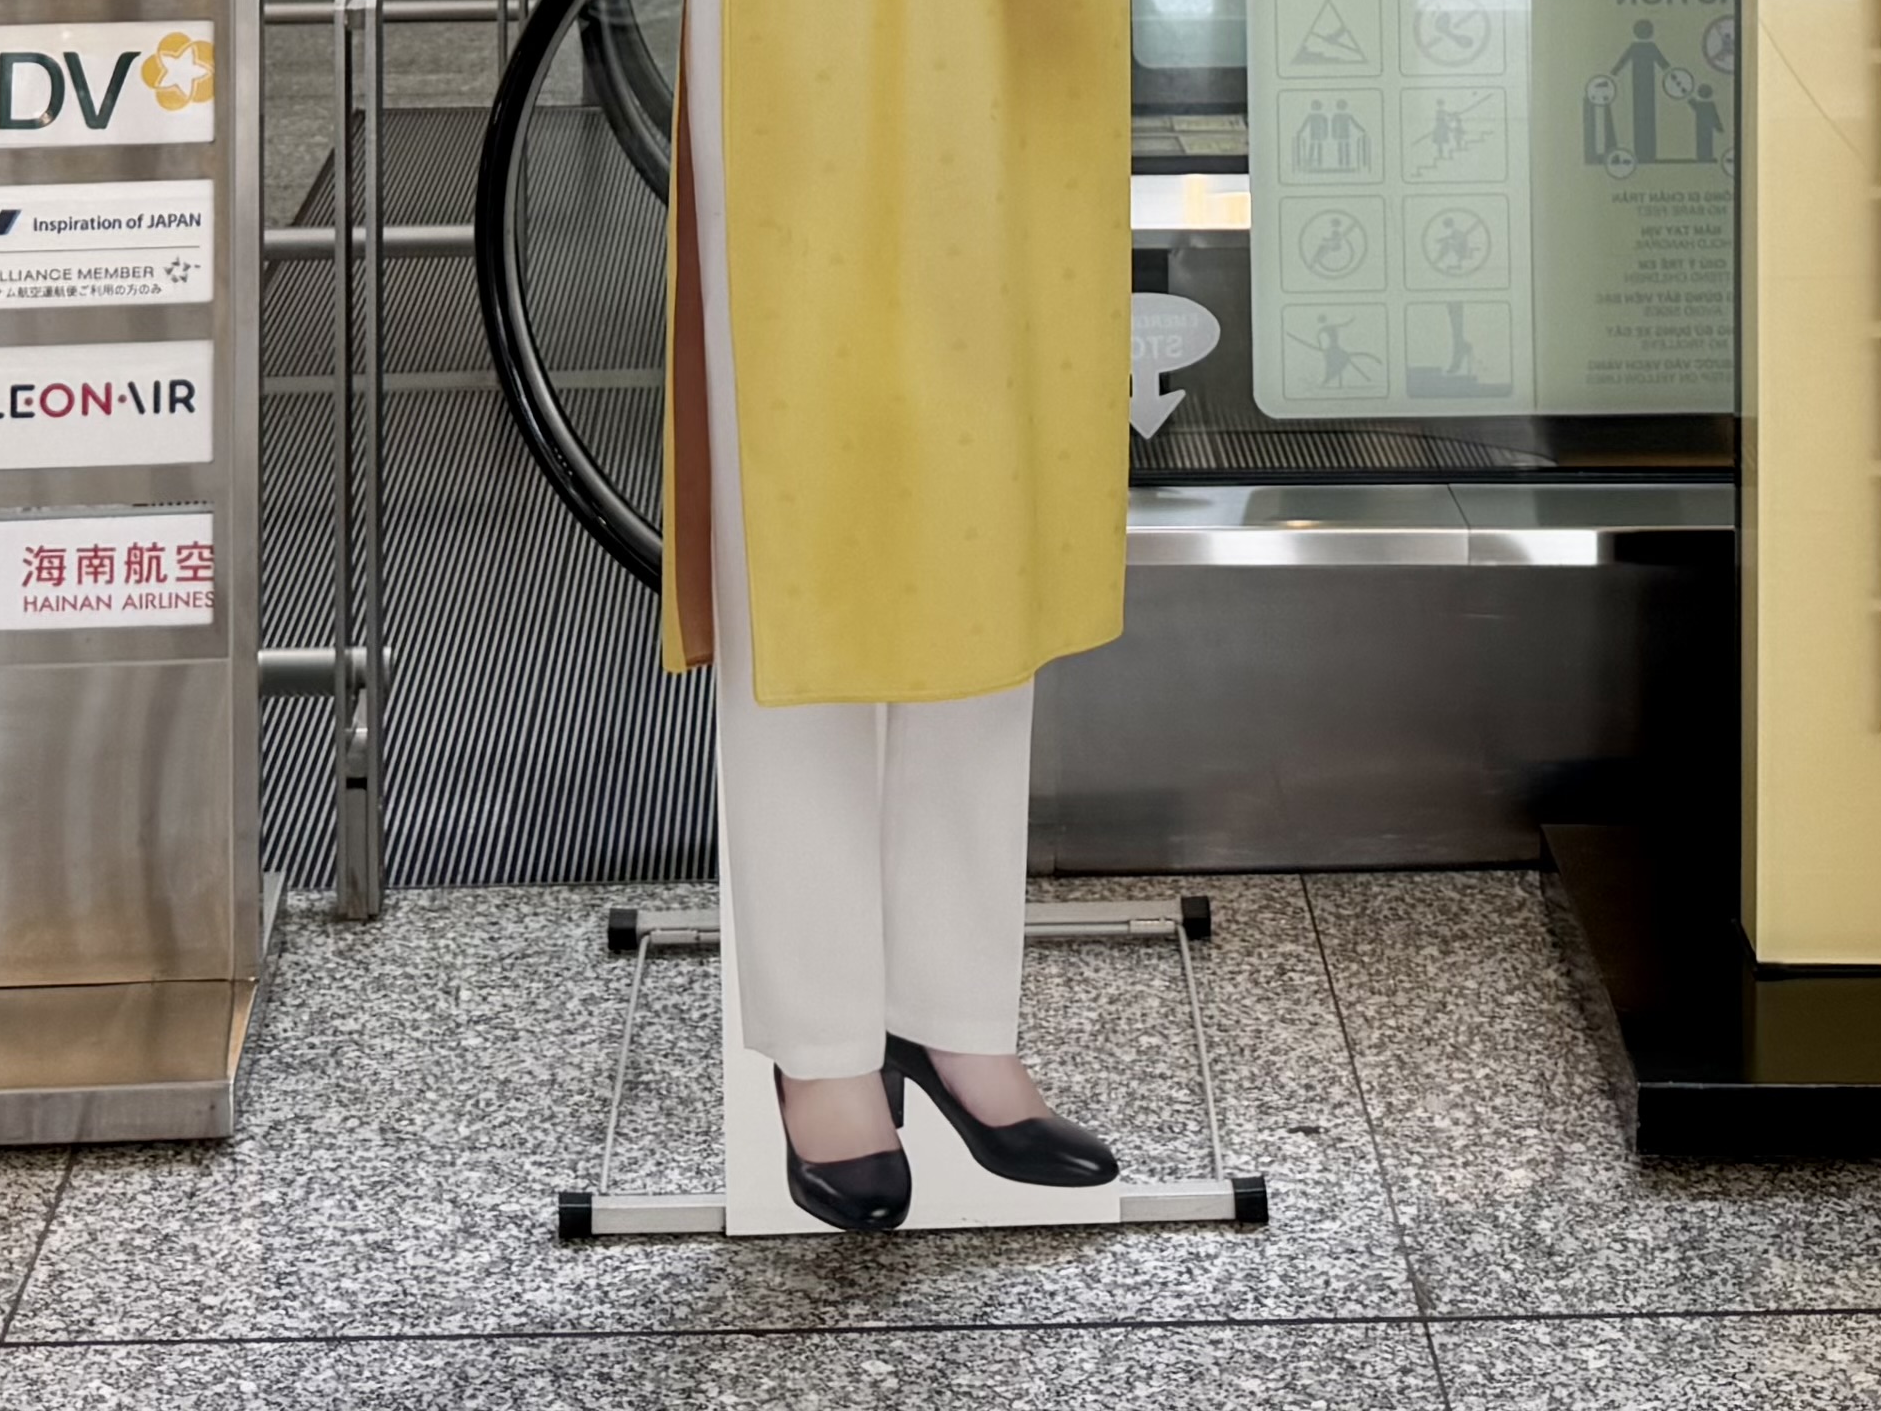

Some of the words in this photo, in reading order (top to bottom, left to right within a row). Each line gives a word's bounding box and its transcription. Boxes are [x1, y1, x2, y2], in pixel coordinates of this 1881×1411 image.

[33, 217, 124, 234] Inspiration
[129, 214, 144, 229] of
[147, 213, 201, 229] JAPAN
[78, 266, 154, 280] MEMBER
[22, 541, 215, 587] 海南航空
[24, 595, 112, 612] HAINAN
[122, 591, 215, 610] AIRLINES
